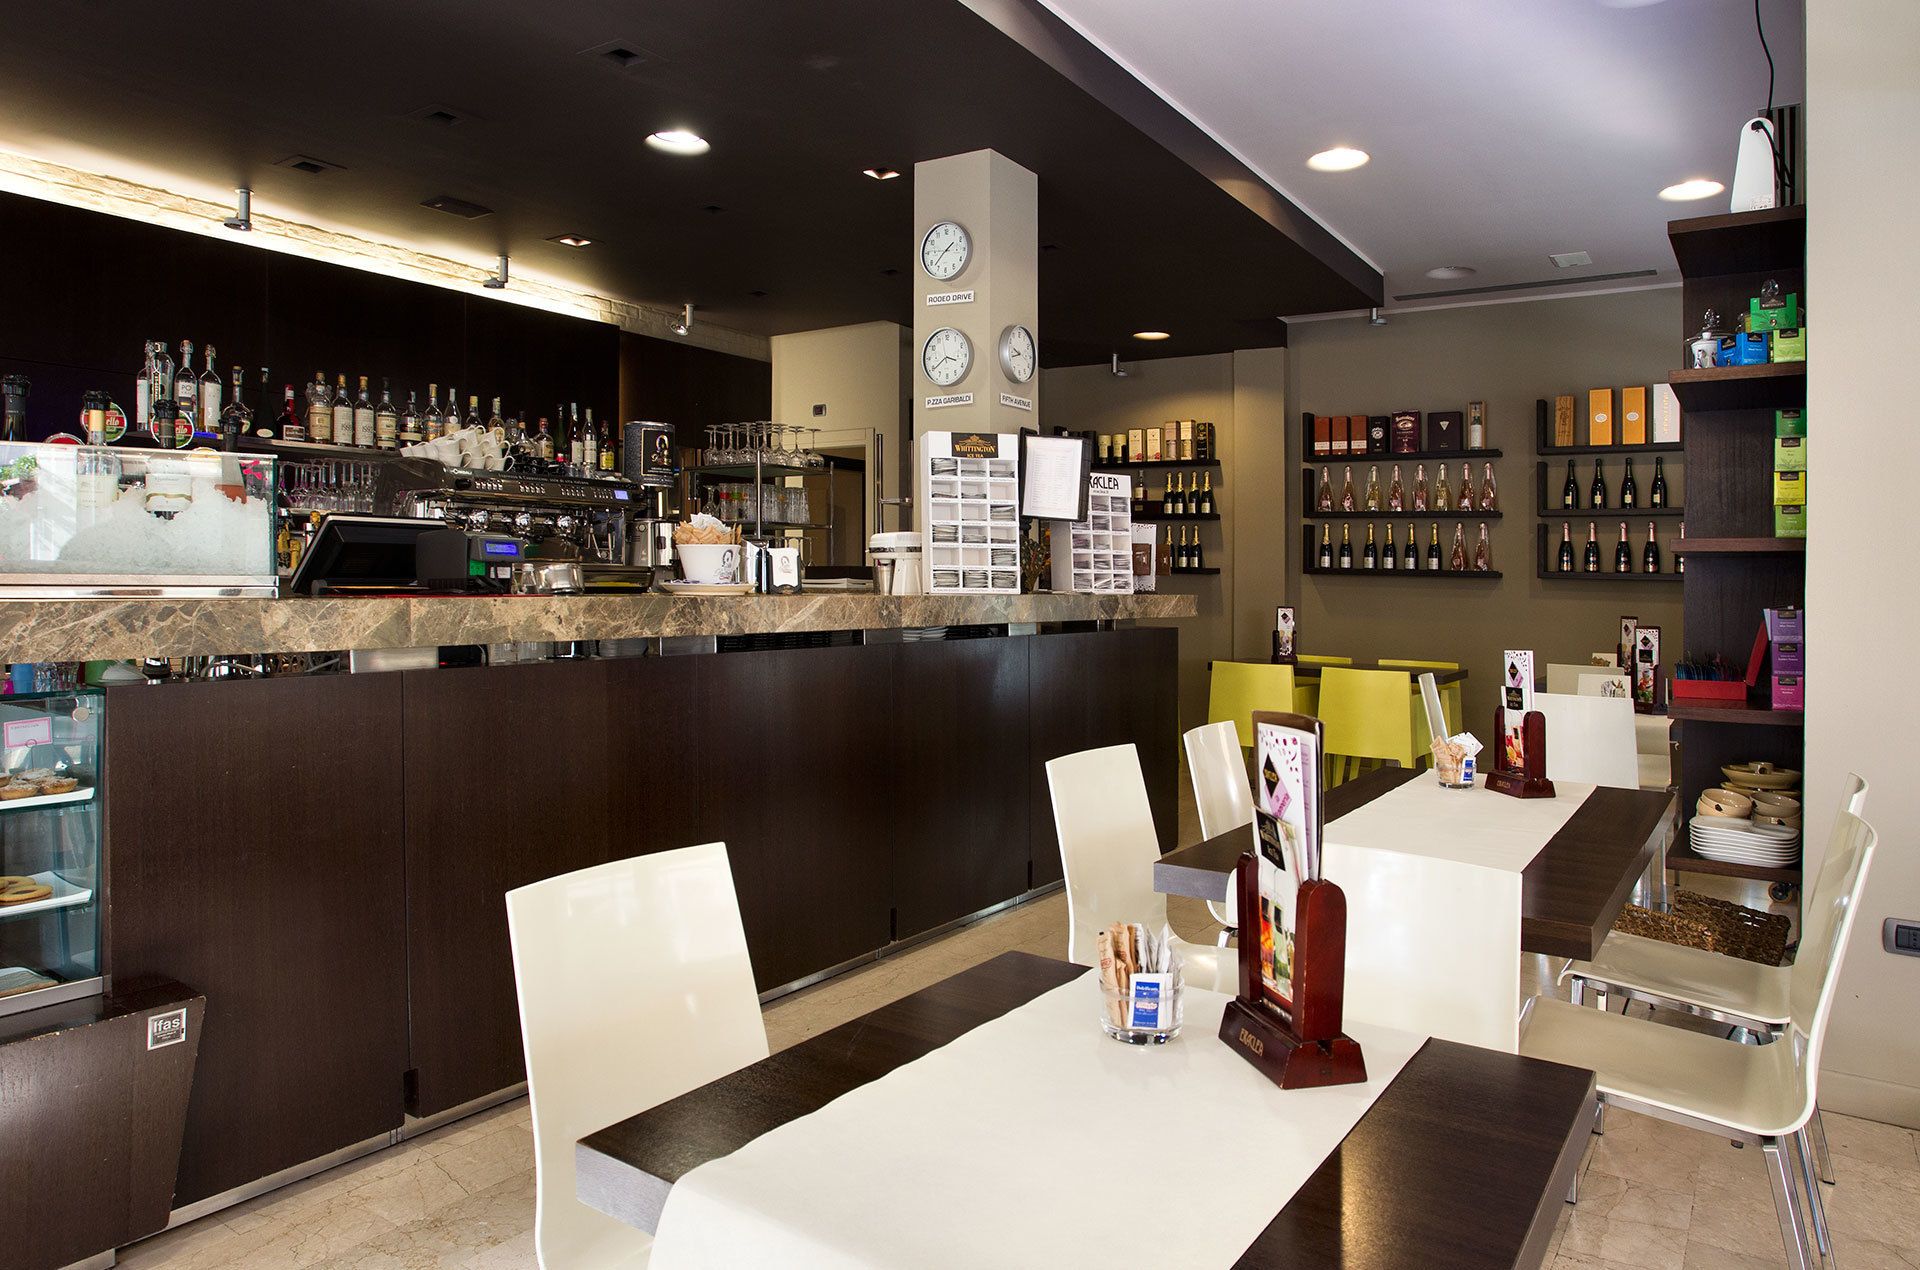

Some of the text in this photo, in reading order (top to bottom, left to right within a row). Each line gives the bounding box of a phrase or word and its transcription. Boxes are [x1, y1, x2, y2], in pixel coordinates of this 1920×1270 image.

[928, 292, 972, 303] RODEO DRIVE
[943, 395, 971, 404] GARIBALDI
[1014, 398, 1031, 408] AVENUE
[954, 444, 995, 453] WHITTINGTON
[1090, 475, 1119, 490] RACLEA
[1239, 1028, 1264, 1057] ERACLEA
